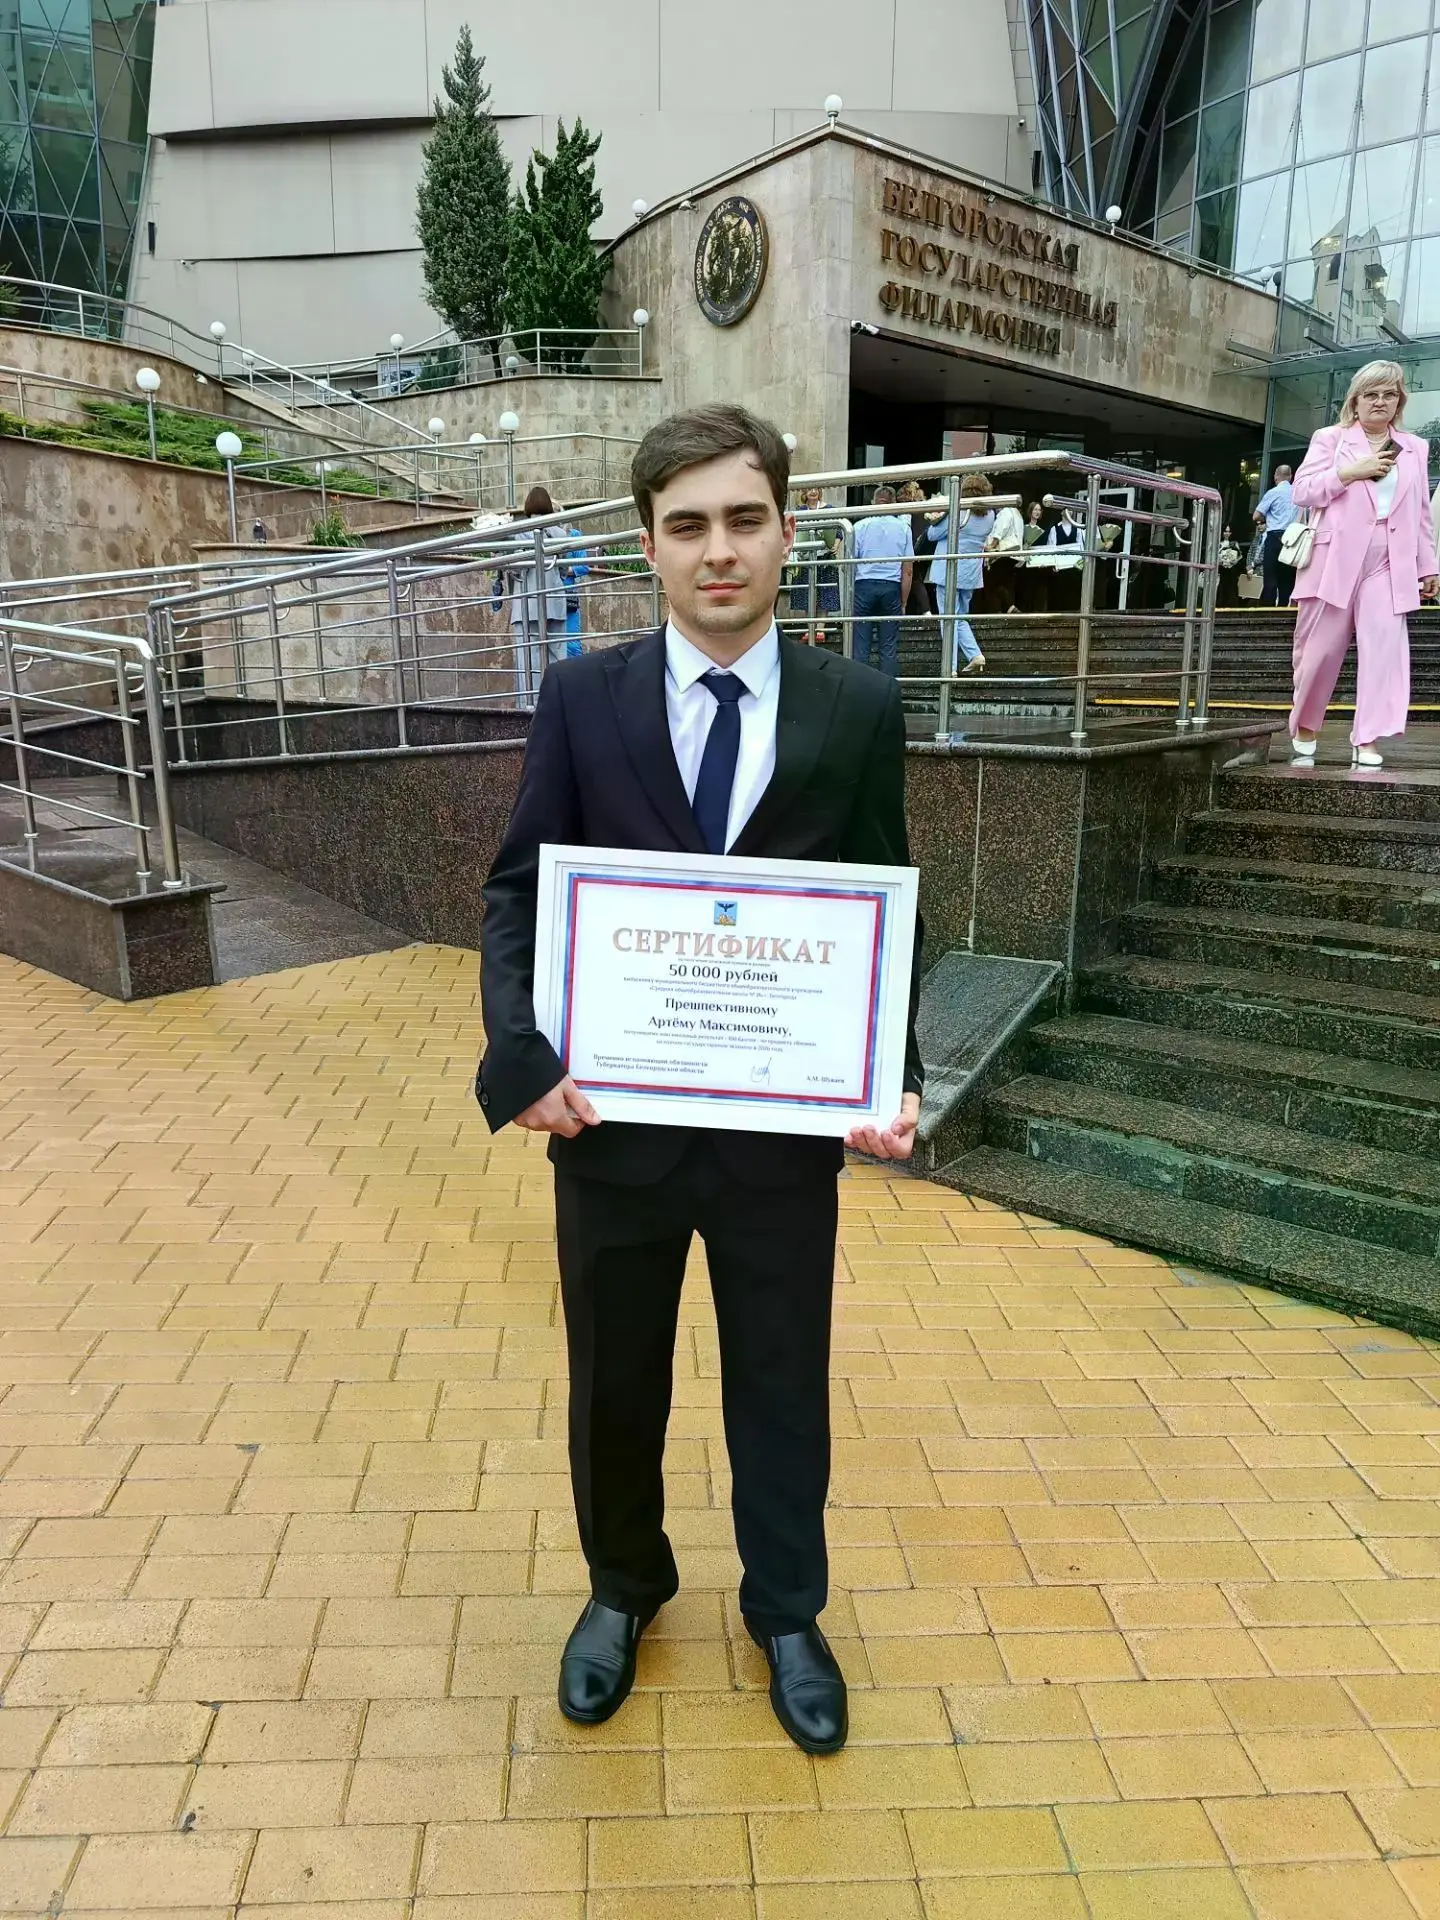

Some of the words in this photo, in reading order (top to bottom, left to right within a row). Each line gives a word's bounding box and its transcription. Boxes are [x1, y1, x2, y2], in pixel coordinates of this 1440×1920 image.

[883, 177, 1080, 271] БЕЛГОРОДСКАЯ
[880, 228, 1119, 328] ГОСУДАРСТВЕННАЯ
[878, 280, 1061, 355] ФИЛАРМОНИЯ
[611, 926, 836, 965] СЕРТИФИКАТ
[669, 963, 687, 977] 50
[692, 965, 721, 979] 000
[725, 969, 778, 983] рублей
[648, 1015, 696, 1032] Артёму
[699, 1019, 792, 1037] Максимовичу,
[665, 996, 778, 1018] Прешпективному
